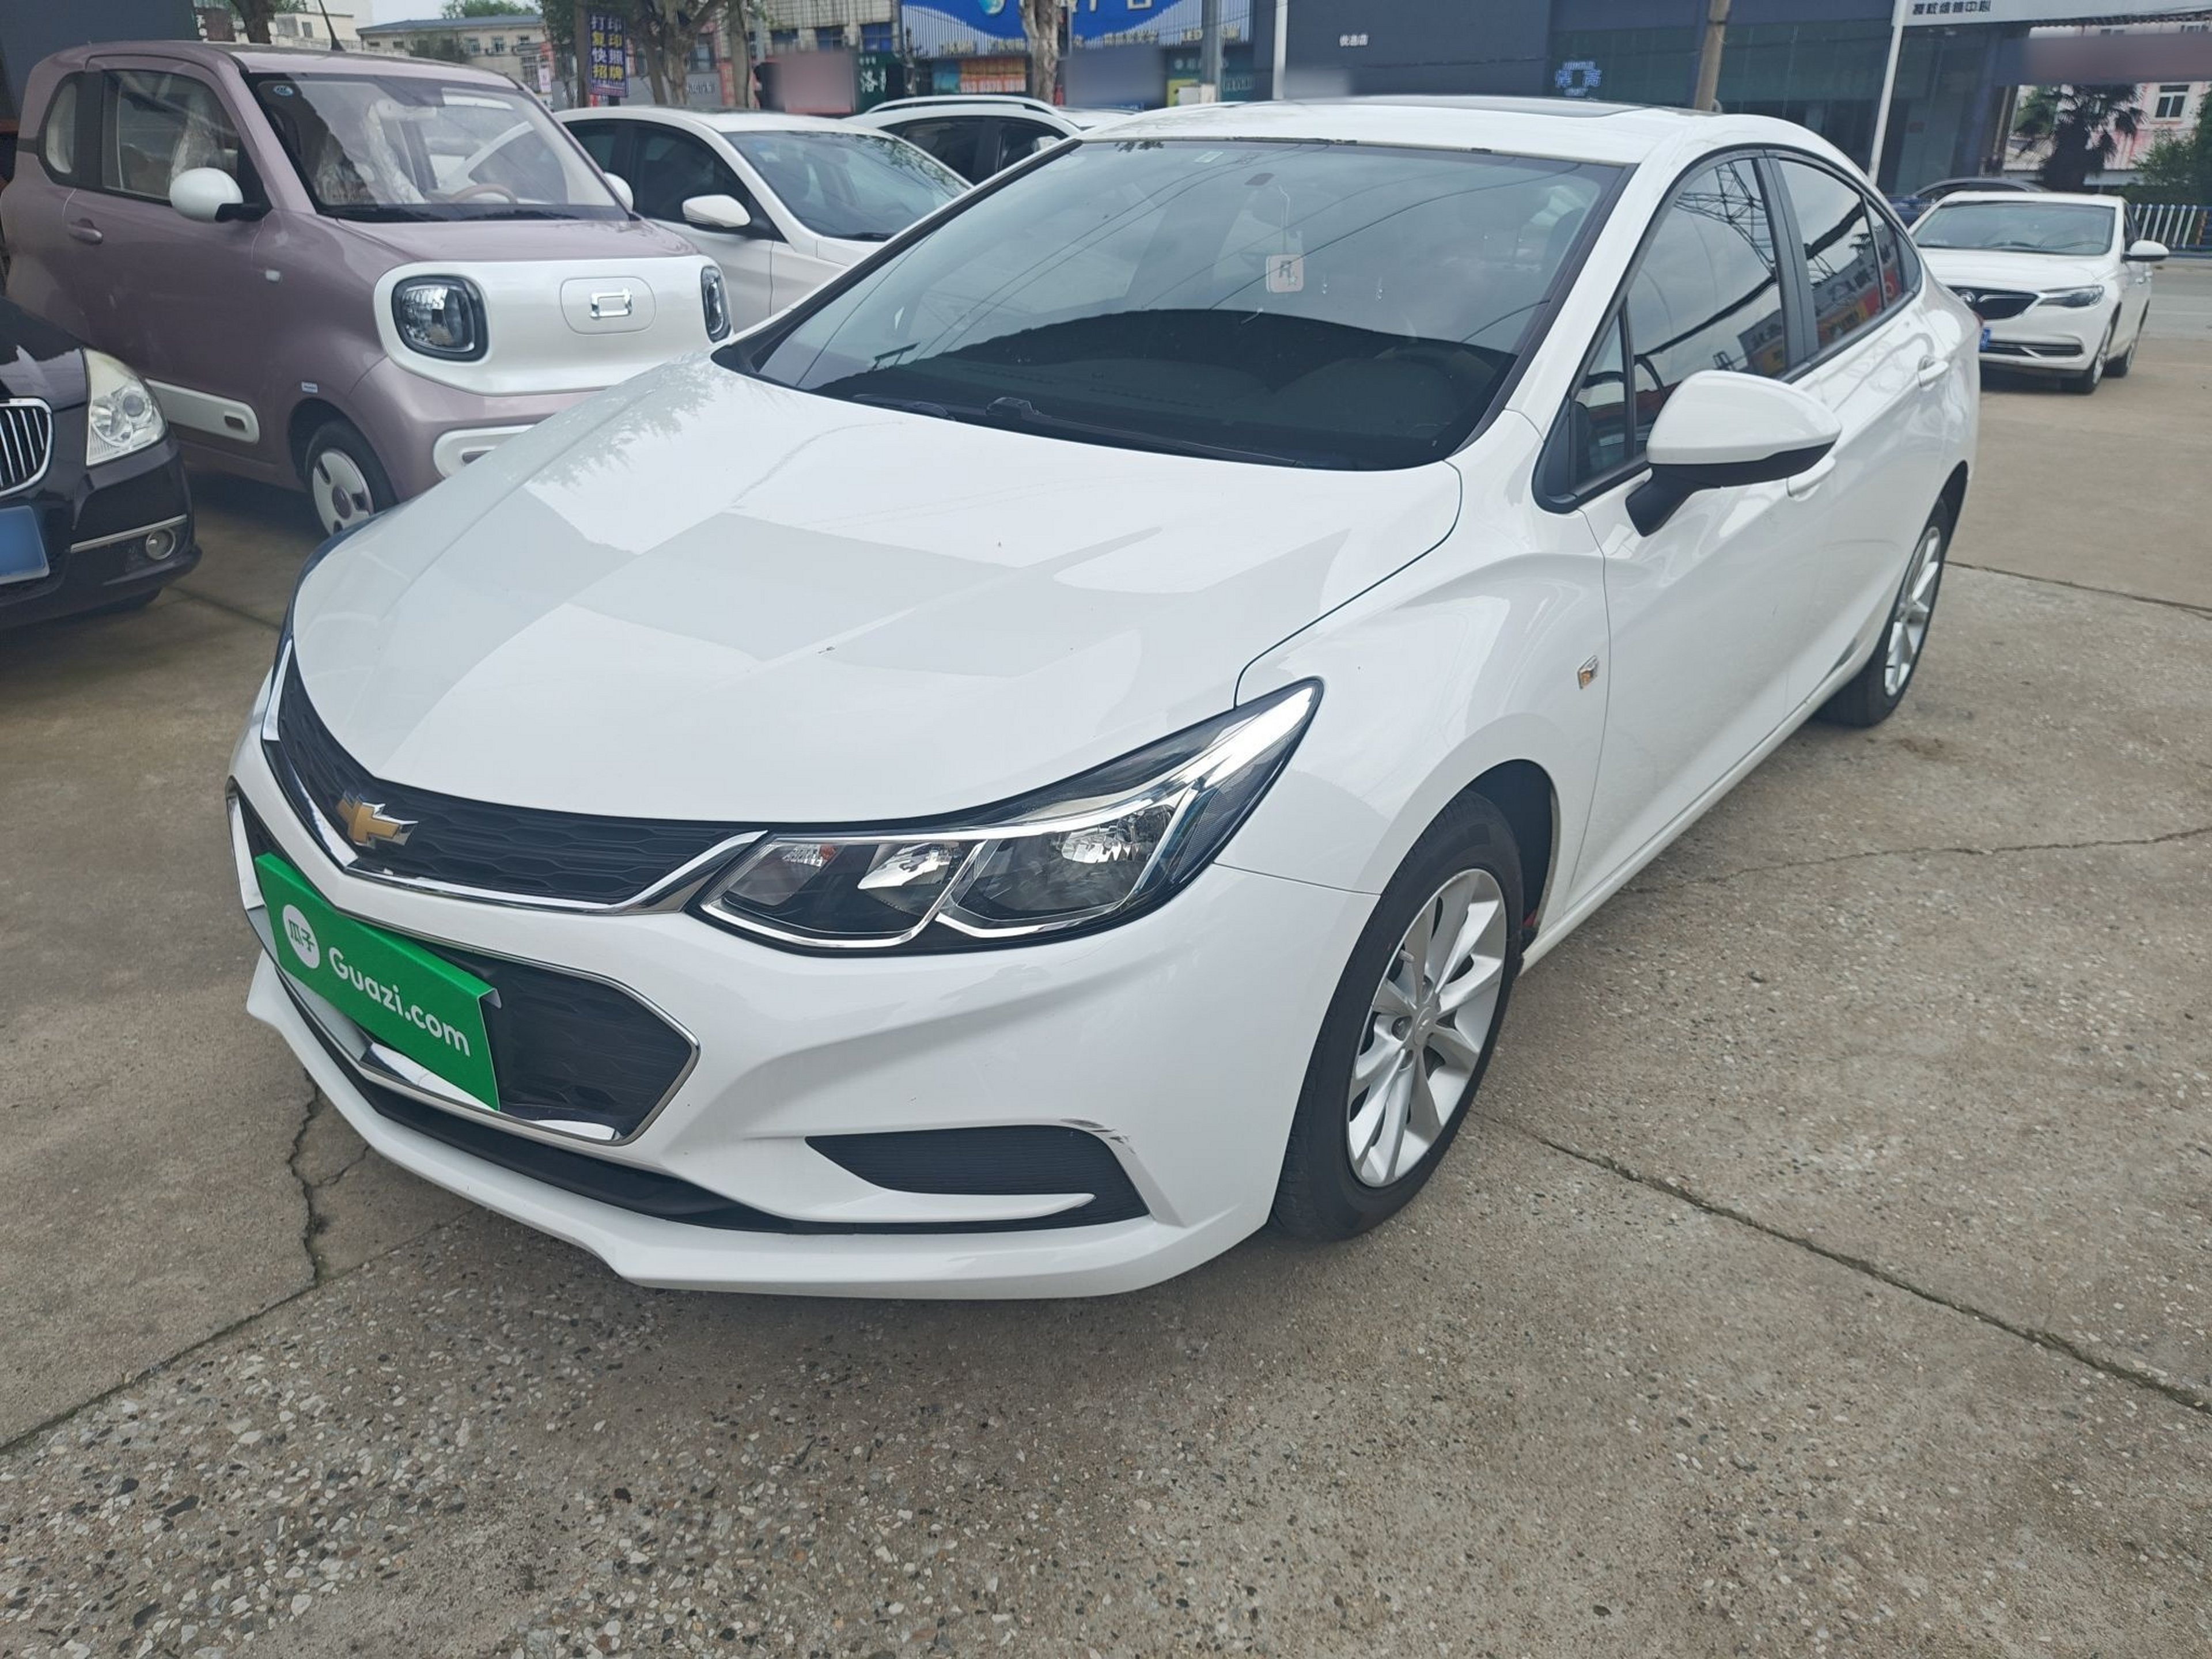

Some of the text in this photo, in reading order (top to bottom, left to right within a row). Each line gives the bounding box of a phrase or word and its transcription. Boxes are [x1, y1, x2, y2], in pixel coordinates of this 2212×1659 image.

[591, 15, 622, 32] 打印
[592, 31, 623, 48] 复印
[592, 47, 623, 65] 快照
[592, 63, 624, 80] 招牌
[328, 947, 470, 1057] Guazi.com
